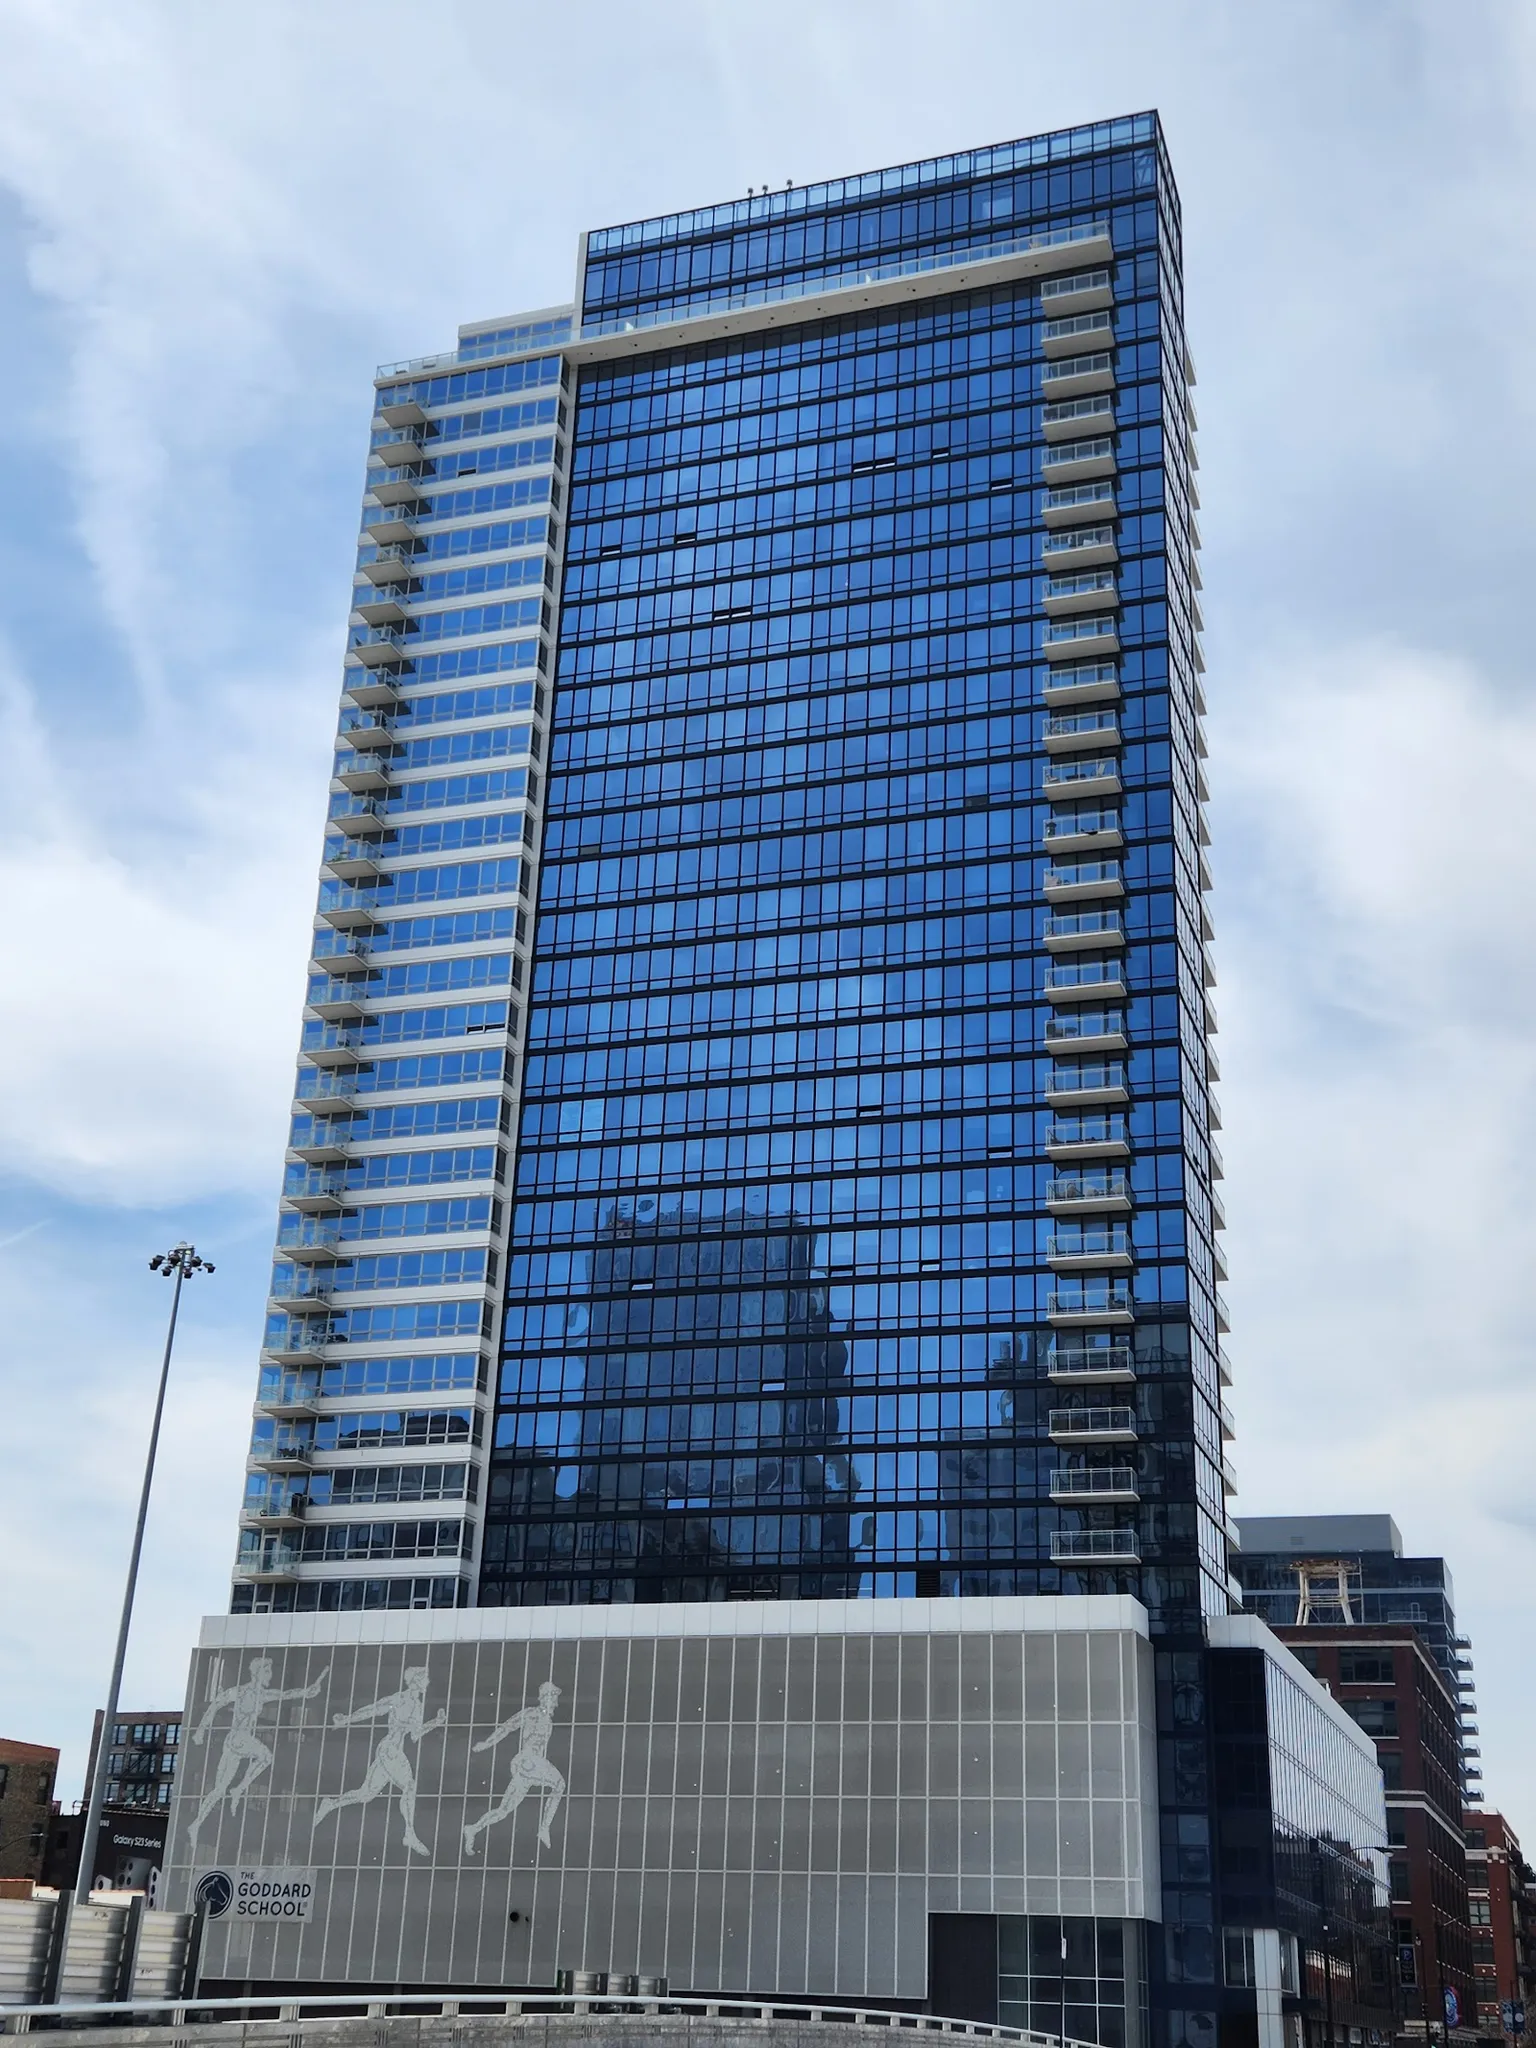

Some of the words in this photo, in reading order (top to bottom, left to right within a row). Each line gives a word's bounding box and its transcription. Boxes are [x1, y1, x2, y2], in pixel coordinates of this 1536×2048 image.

[113, 1834, 134, 1847] Galaxy
[134, 1836, 144, 1846] S23
[144, 1838, 161, 1848] Series
[241, 1872, 255, 1880] THE
[238, 1882, 311, 1898] GODDARD
[237, 1900, 305, 1916] SCHOOL
